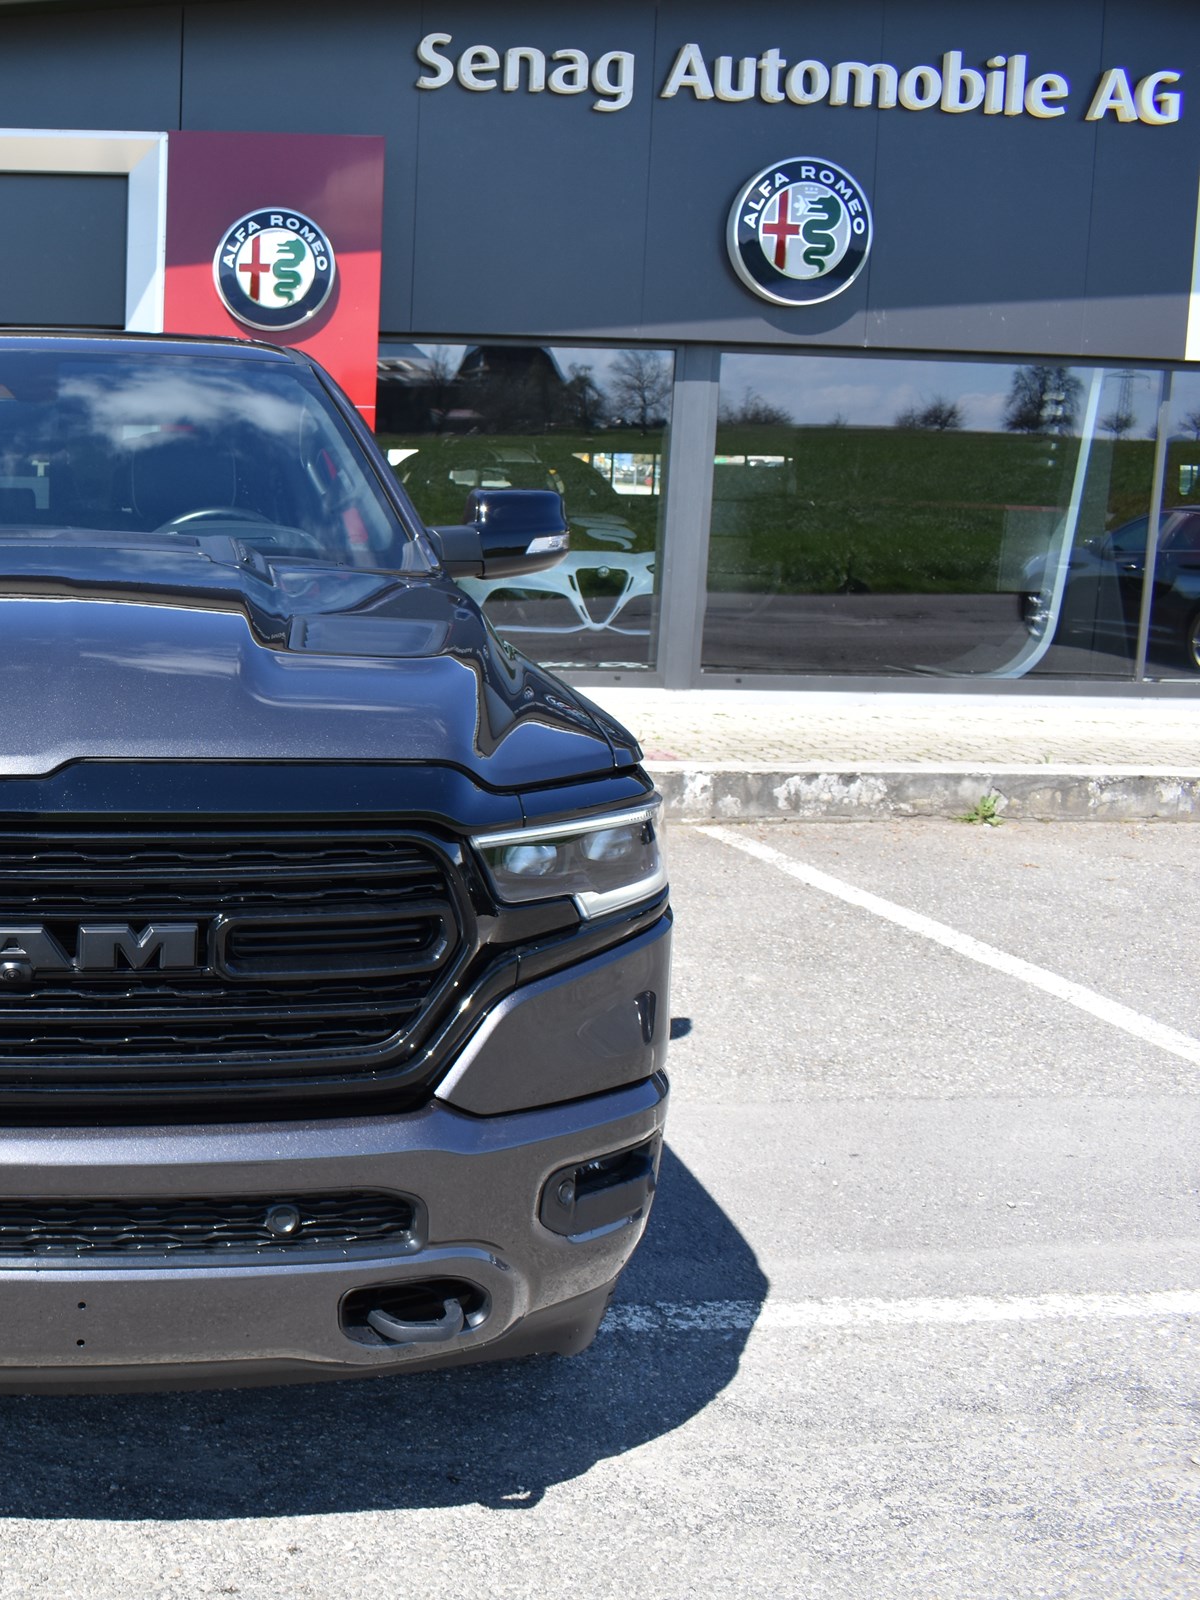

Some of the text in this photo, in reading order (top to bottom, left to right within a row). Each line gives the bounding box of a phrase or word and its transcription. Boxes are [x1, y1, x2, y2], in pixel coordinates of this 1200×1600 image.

[416, 32, 1182, 125] Senag Automobile AG
[743, 165, 866, 235] ALFA ROMEO
[222, 214, 328, 271] ALFA ROMEO
